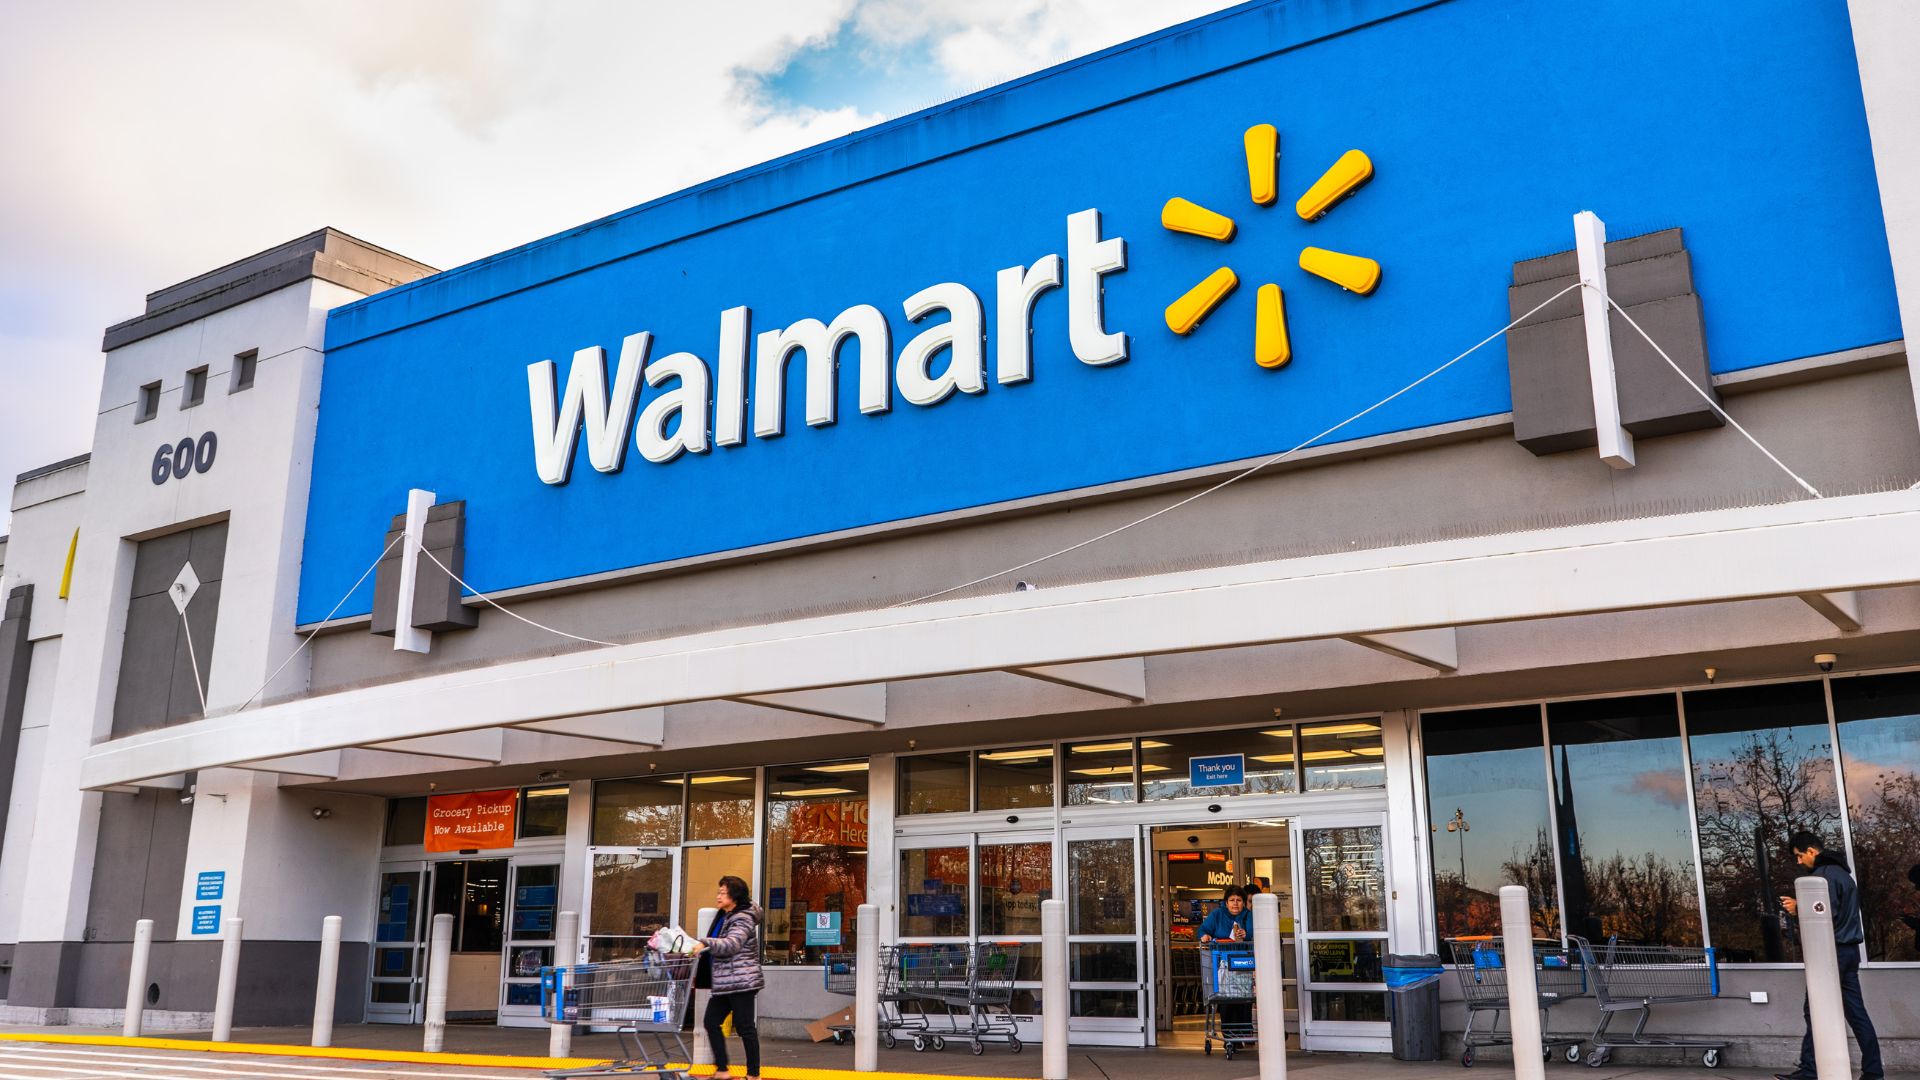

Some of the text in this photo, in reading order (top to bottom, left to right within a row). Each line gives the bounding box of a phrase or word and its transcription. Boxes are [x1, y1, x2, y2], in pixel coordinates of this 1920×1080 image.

[527, 207, 1129, 485] Walmart
[151, 430, 218, 486] 600
[1198, 763, 1236, 773] Thank you
[433, 803, 512, 819] Grocery Pickup
[434, 821, 505, 835] Now Available
